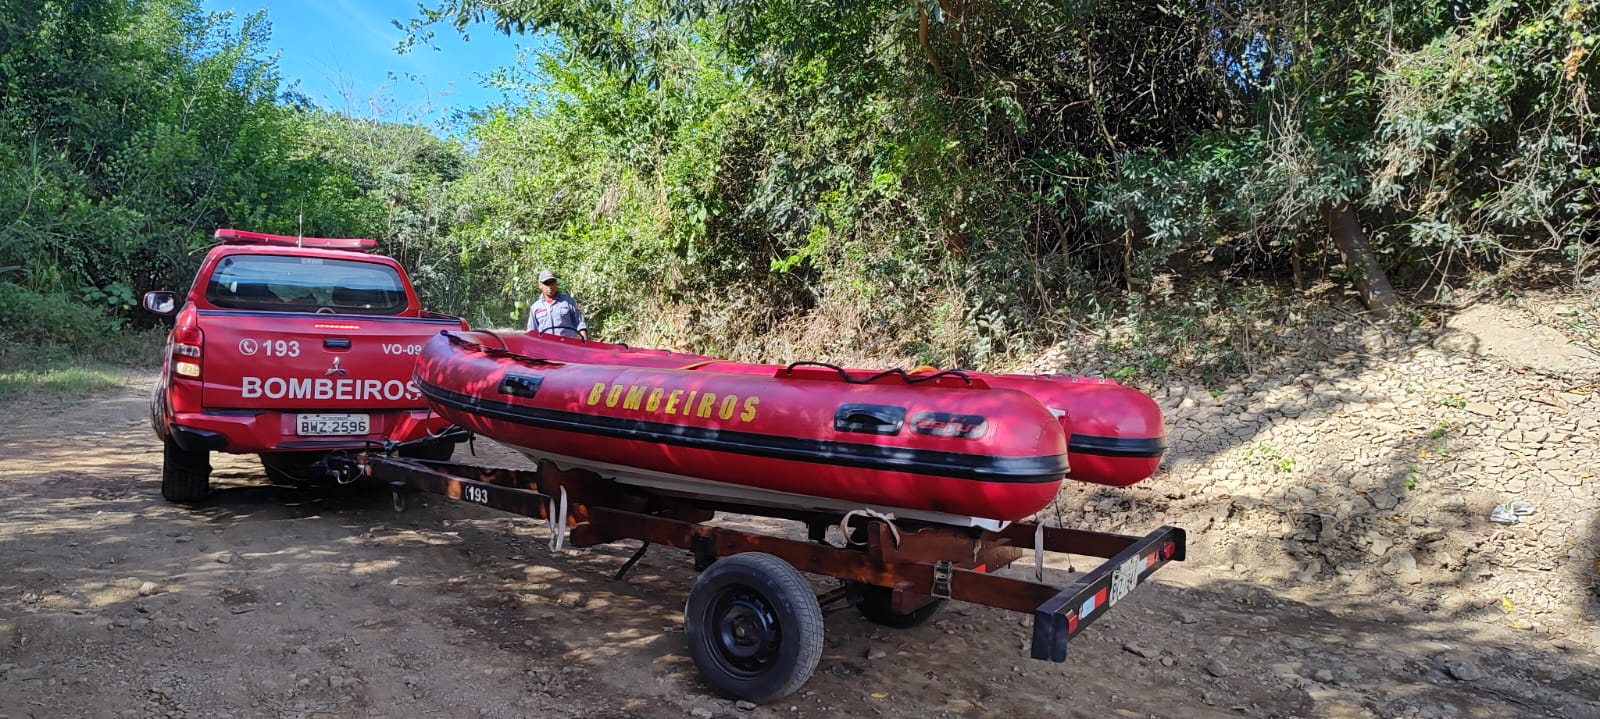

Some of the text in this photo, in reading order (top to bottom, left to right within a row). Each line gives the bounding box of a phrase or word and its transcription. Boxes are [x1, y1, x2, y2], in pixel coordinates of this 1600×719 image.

[262, 339, 300, 358] 193
[382, 343, 425, 355] VO-09
[242, 376, 422, 401] BOMBEIROS
[586, 382, 761, 422] BOMBEIROS
[468, 486, 488, 504] 193
